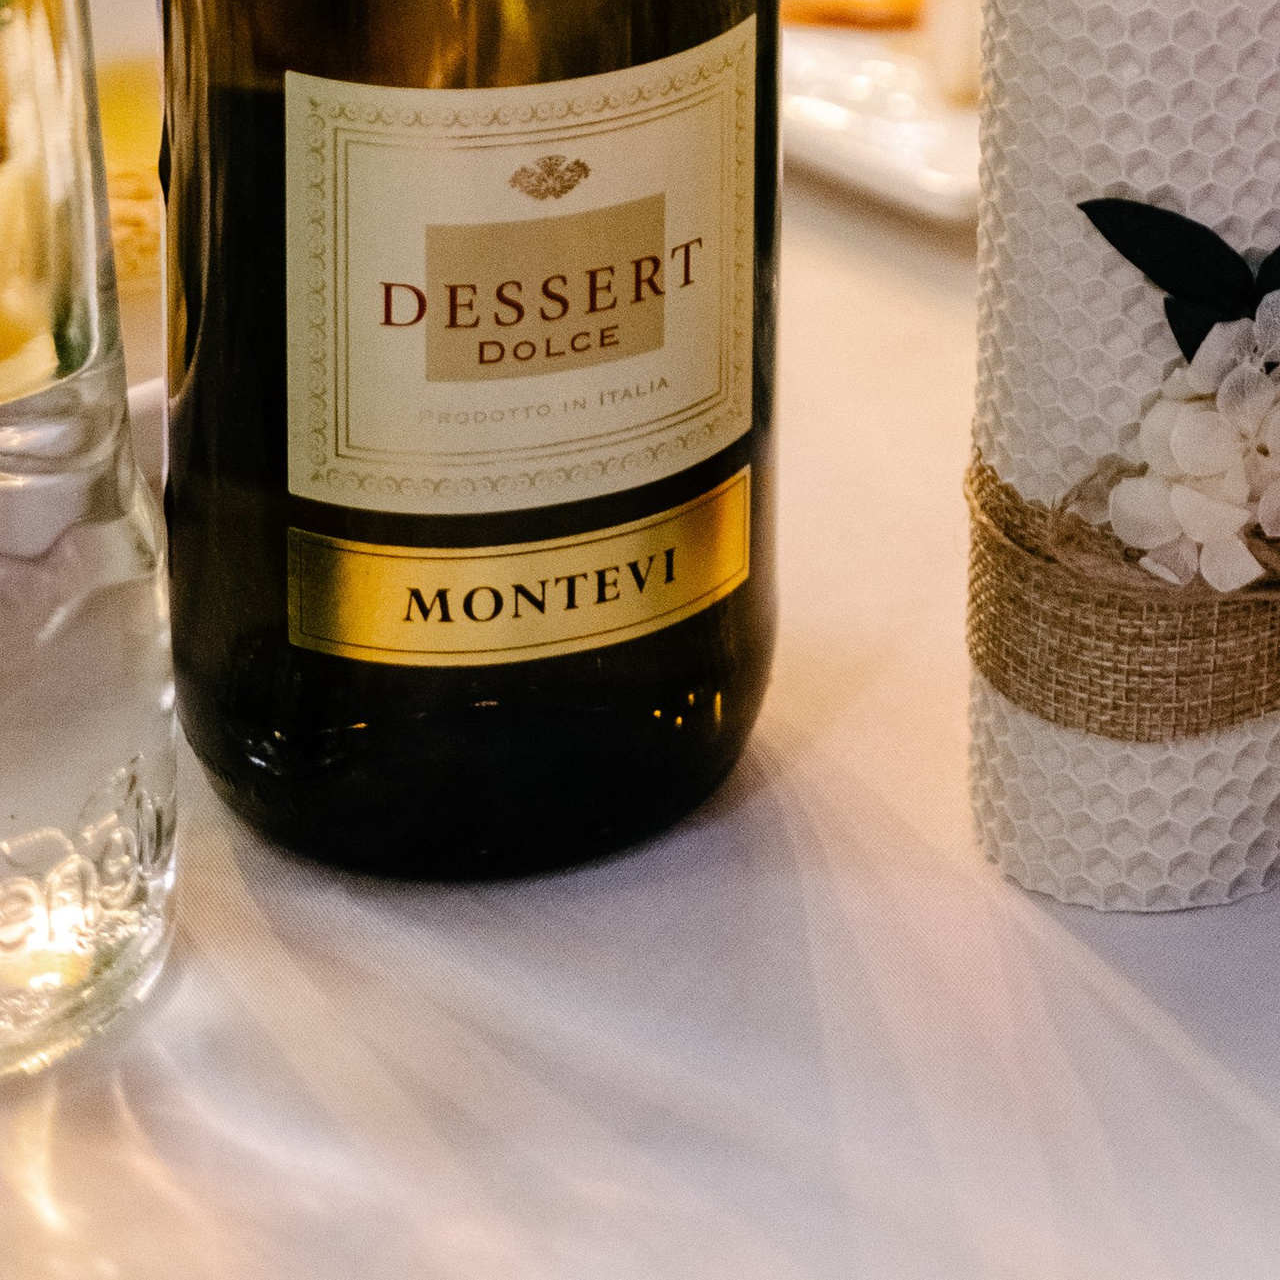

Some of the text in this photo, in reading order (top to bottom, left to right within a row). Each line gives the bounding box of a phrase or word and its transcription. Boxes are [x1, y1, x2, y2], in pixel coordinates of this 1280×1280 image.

[379, 237, 703, 329] DESSERT
[478, 325, 620, 365] DOLCE
[418, 376, 669, 425] PRODOTTO IN ITALIA
[402, 547, 676, 623] MONTEVI
